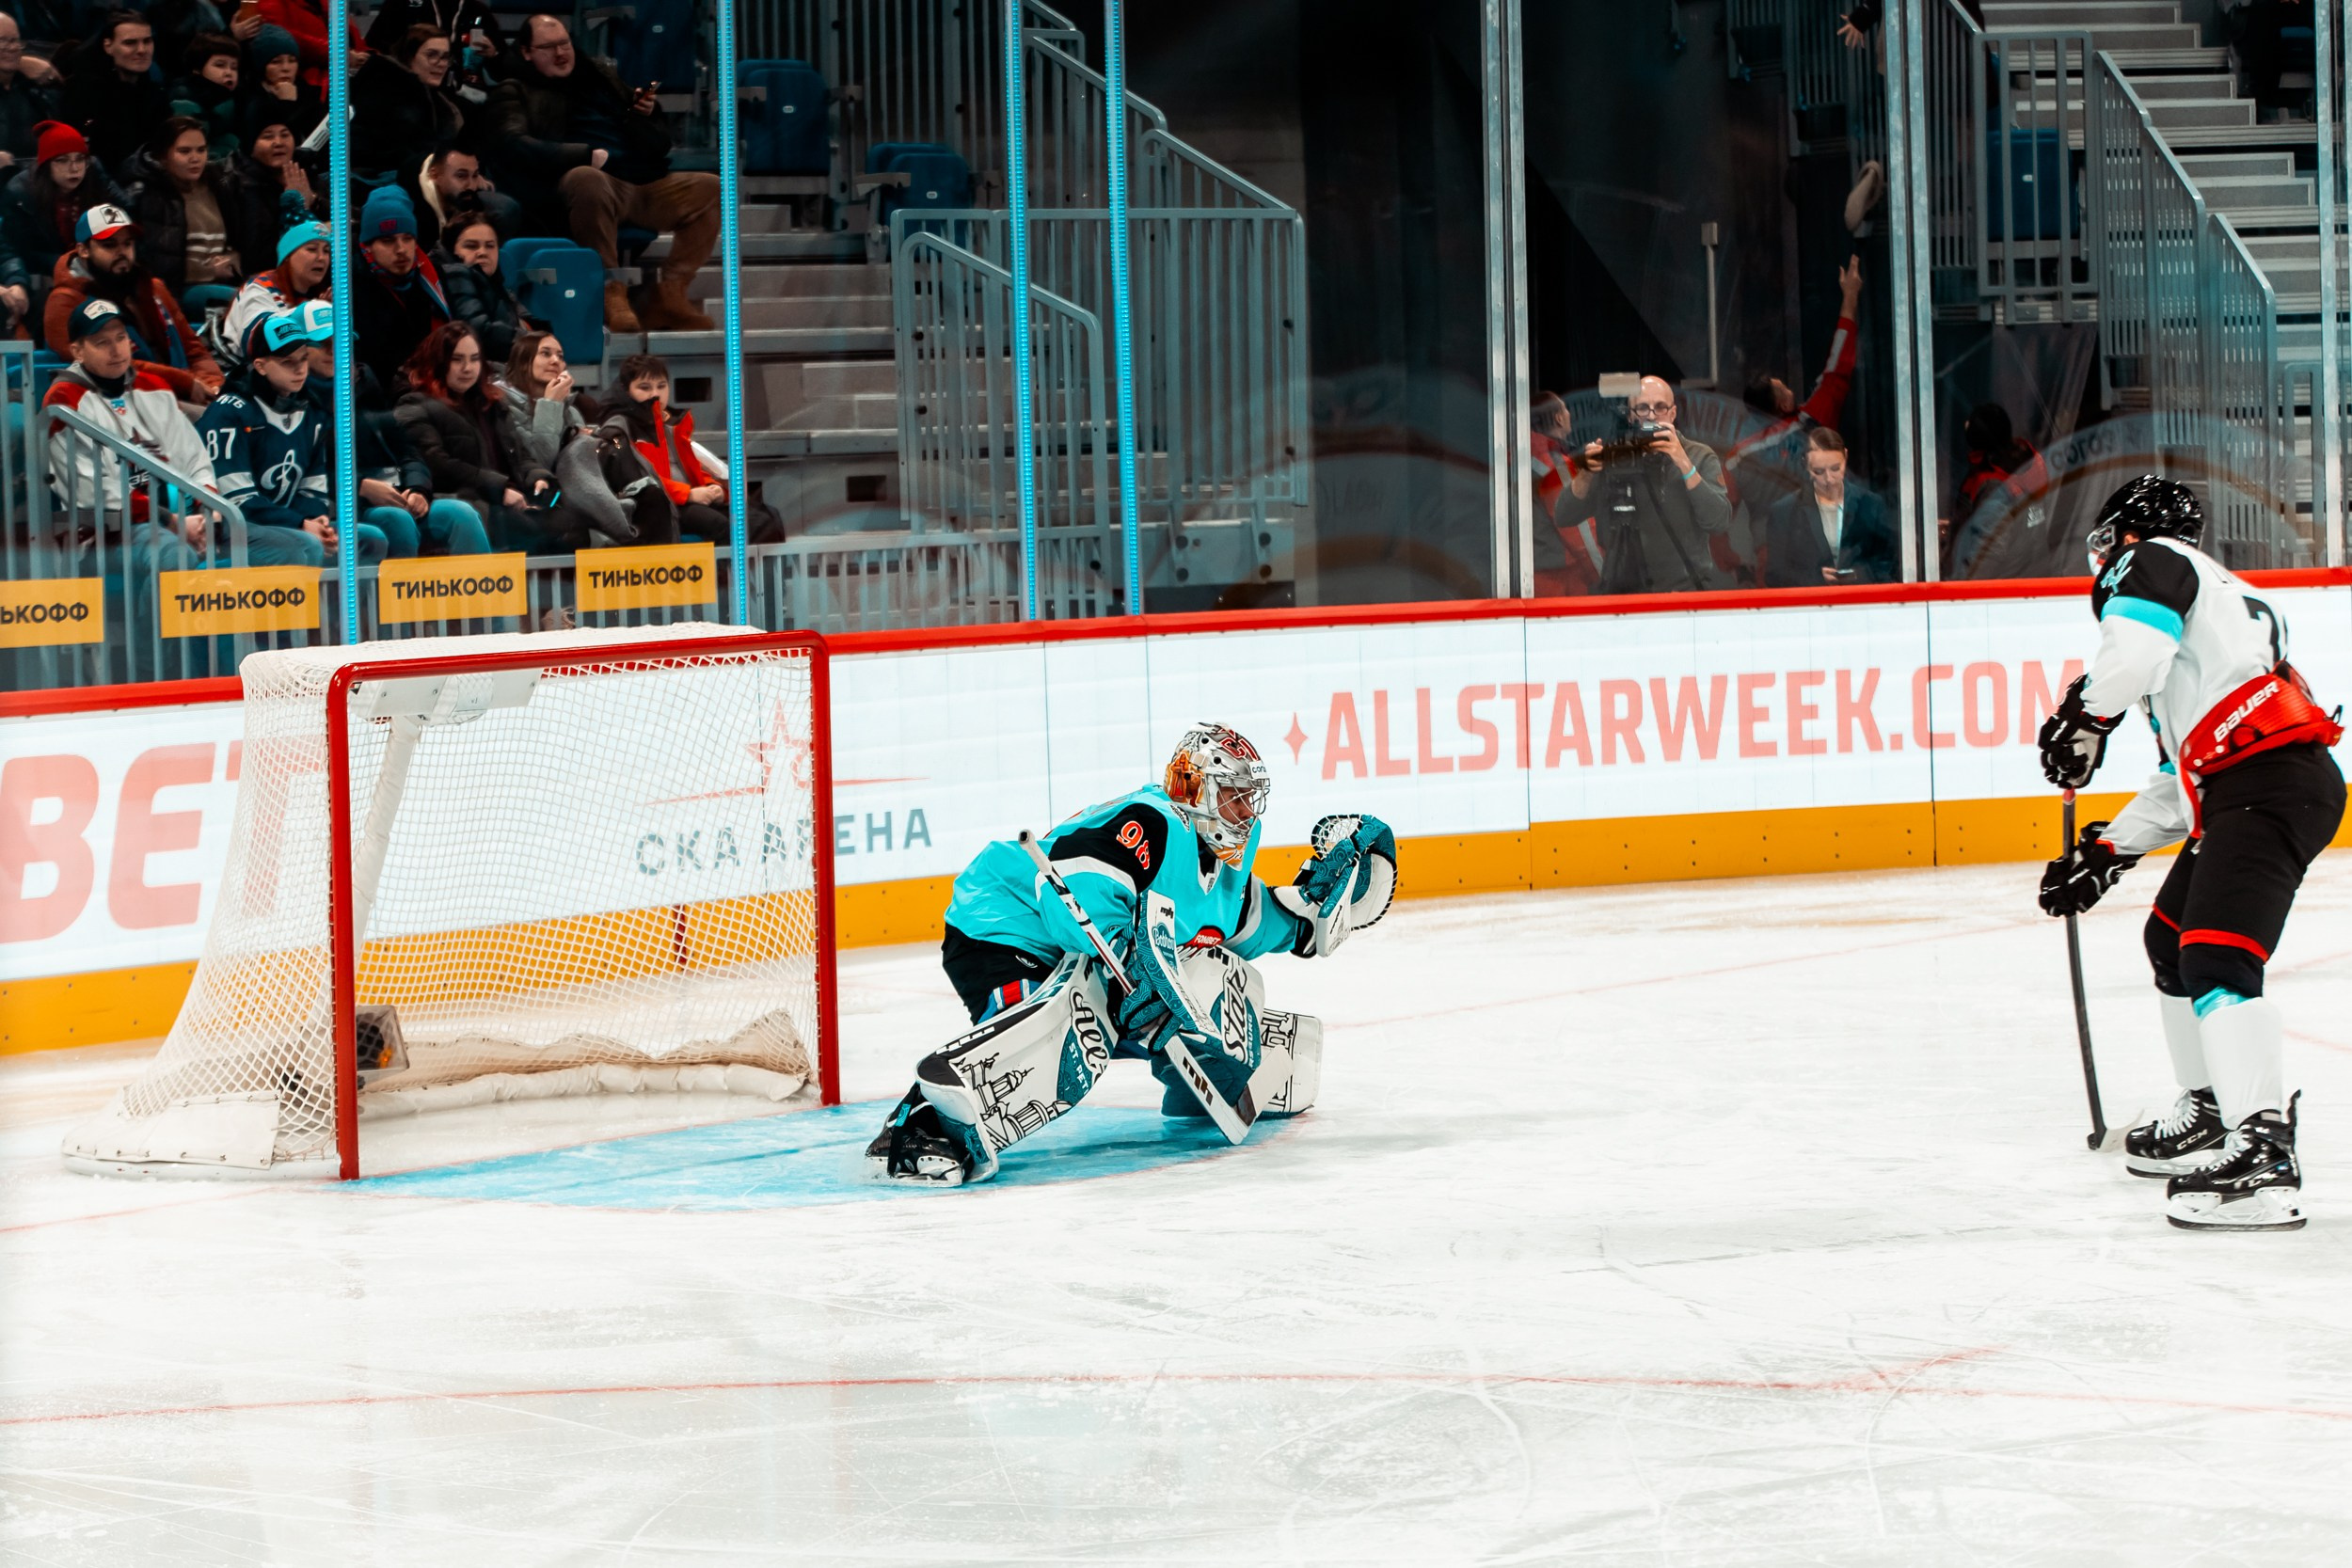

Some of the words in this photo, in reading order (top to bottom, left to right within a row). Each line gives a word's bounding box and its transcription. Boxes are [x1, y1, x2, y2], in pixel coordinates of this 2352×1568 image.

[206, 427, 236, 462] 87
[391, 575, 514, 600] ТИНЬКОФФ
[588, 564, 704, 590] ТИНЬКОФФ
[174, 587, 306, 613] ТИНЬКОФФ
[1321, 658, 2083, 781] ALLSTARWEEK.COM
[635, 827, 741, 877] СКА
[1116, 820, 1151, 870] 98
[2176, 1129, 2208, 1151] CCM
